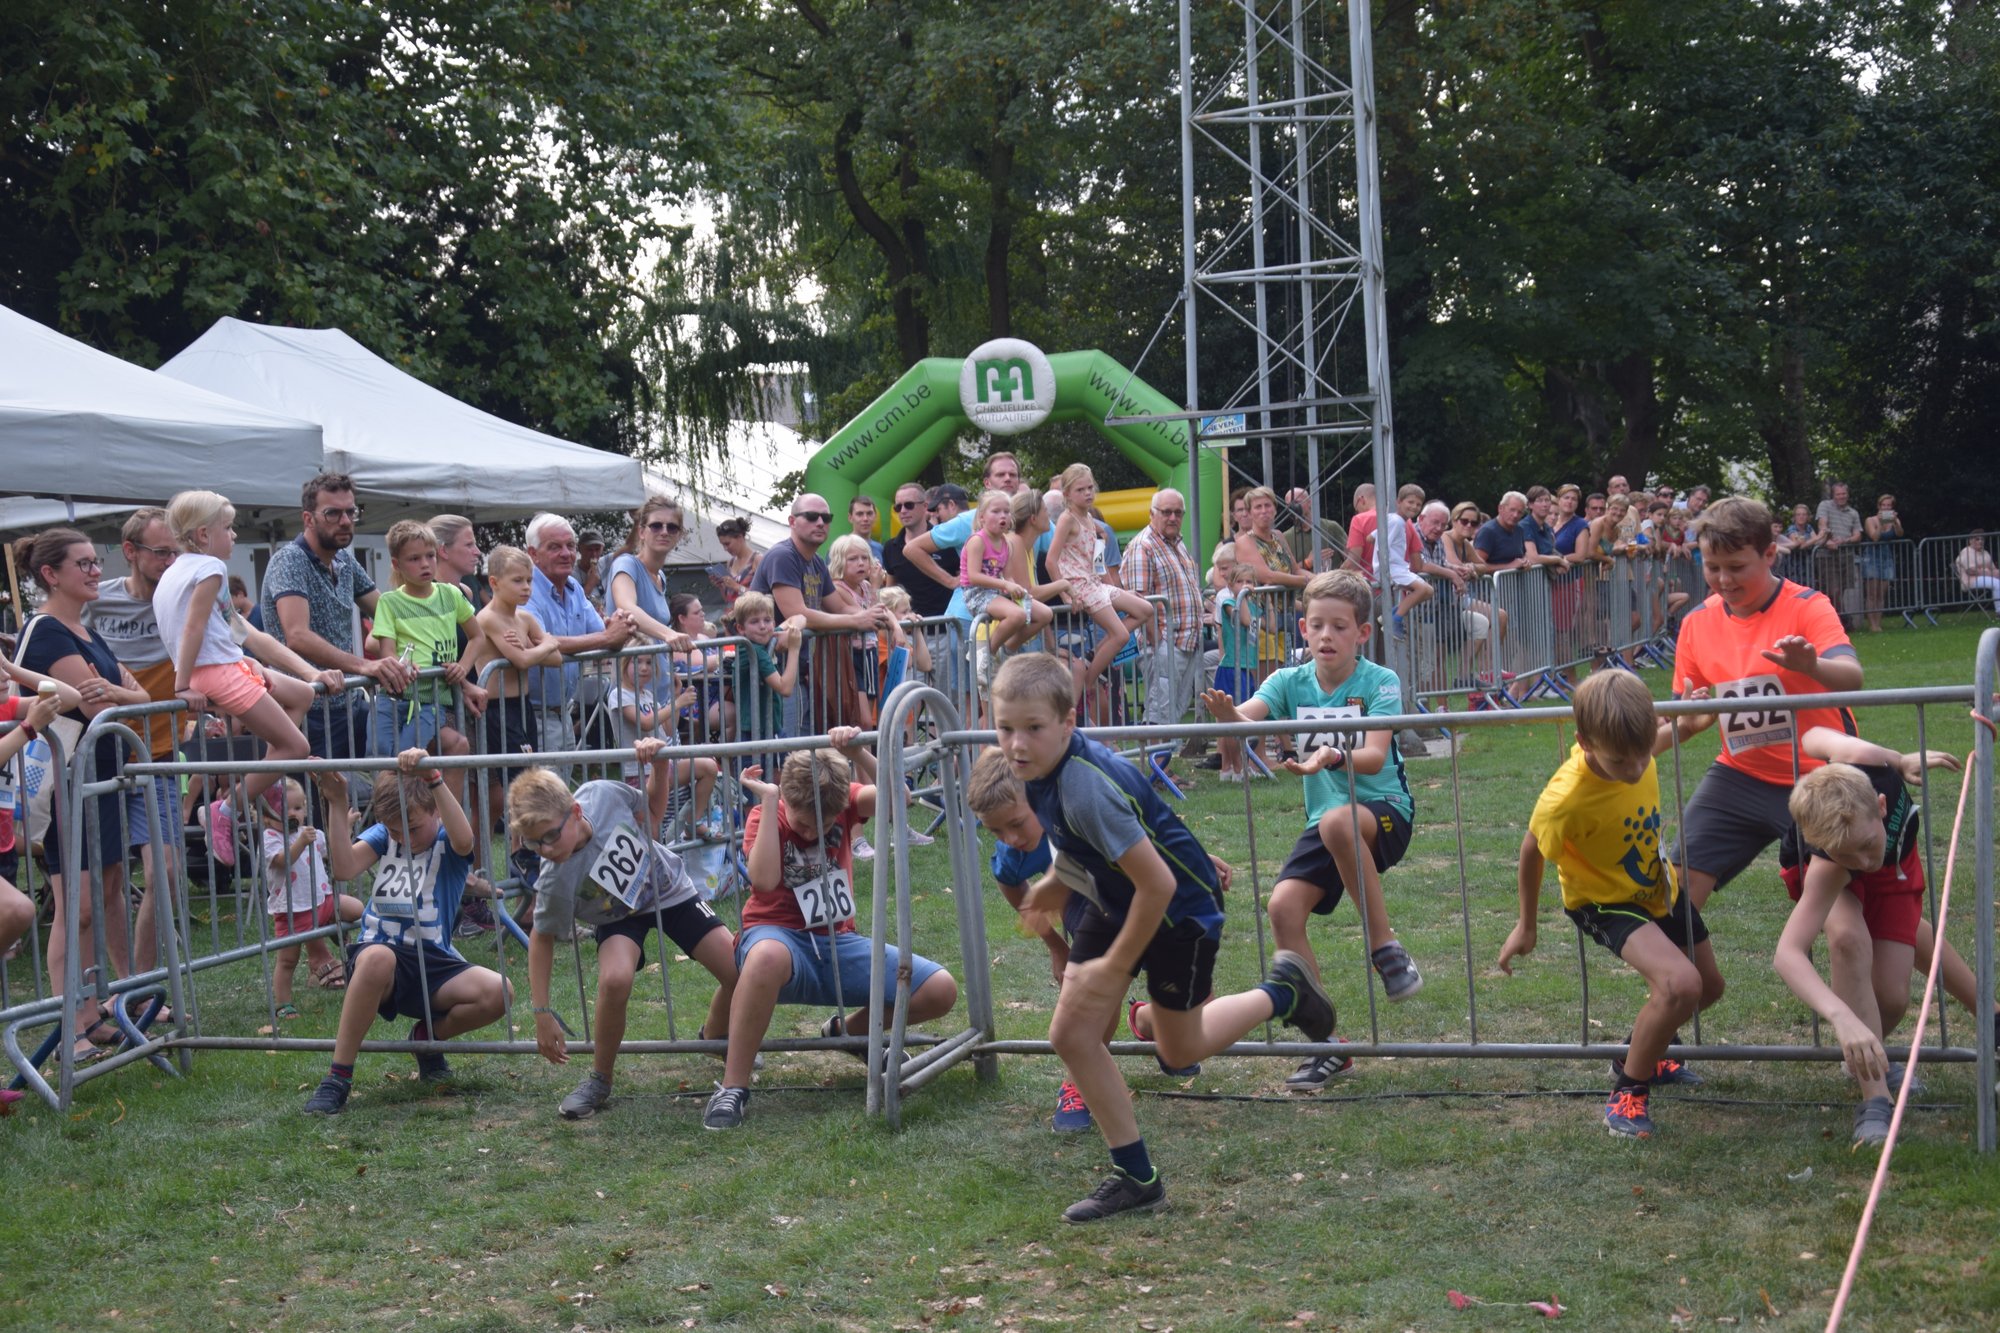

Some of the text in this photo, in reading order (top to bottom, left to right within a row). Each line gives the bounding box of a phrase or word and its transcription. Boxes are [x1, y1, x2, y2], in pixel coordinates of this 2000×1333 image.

[827, 384, 931, 470] www.cm.be
[976, 412, 1033, 424] MUTUALITEIT
[1723, 682, 1787, 733] 252
[597, 834, 643, 895] 262
[802, 878, 852, 924] 256
